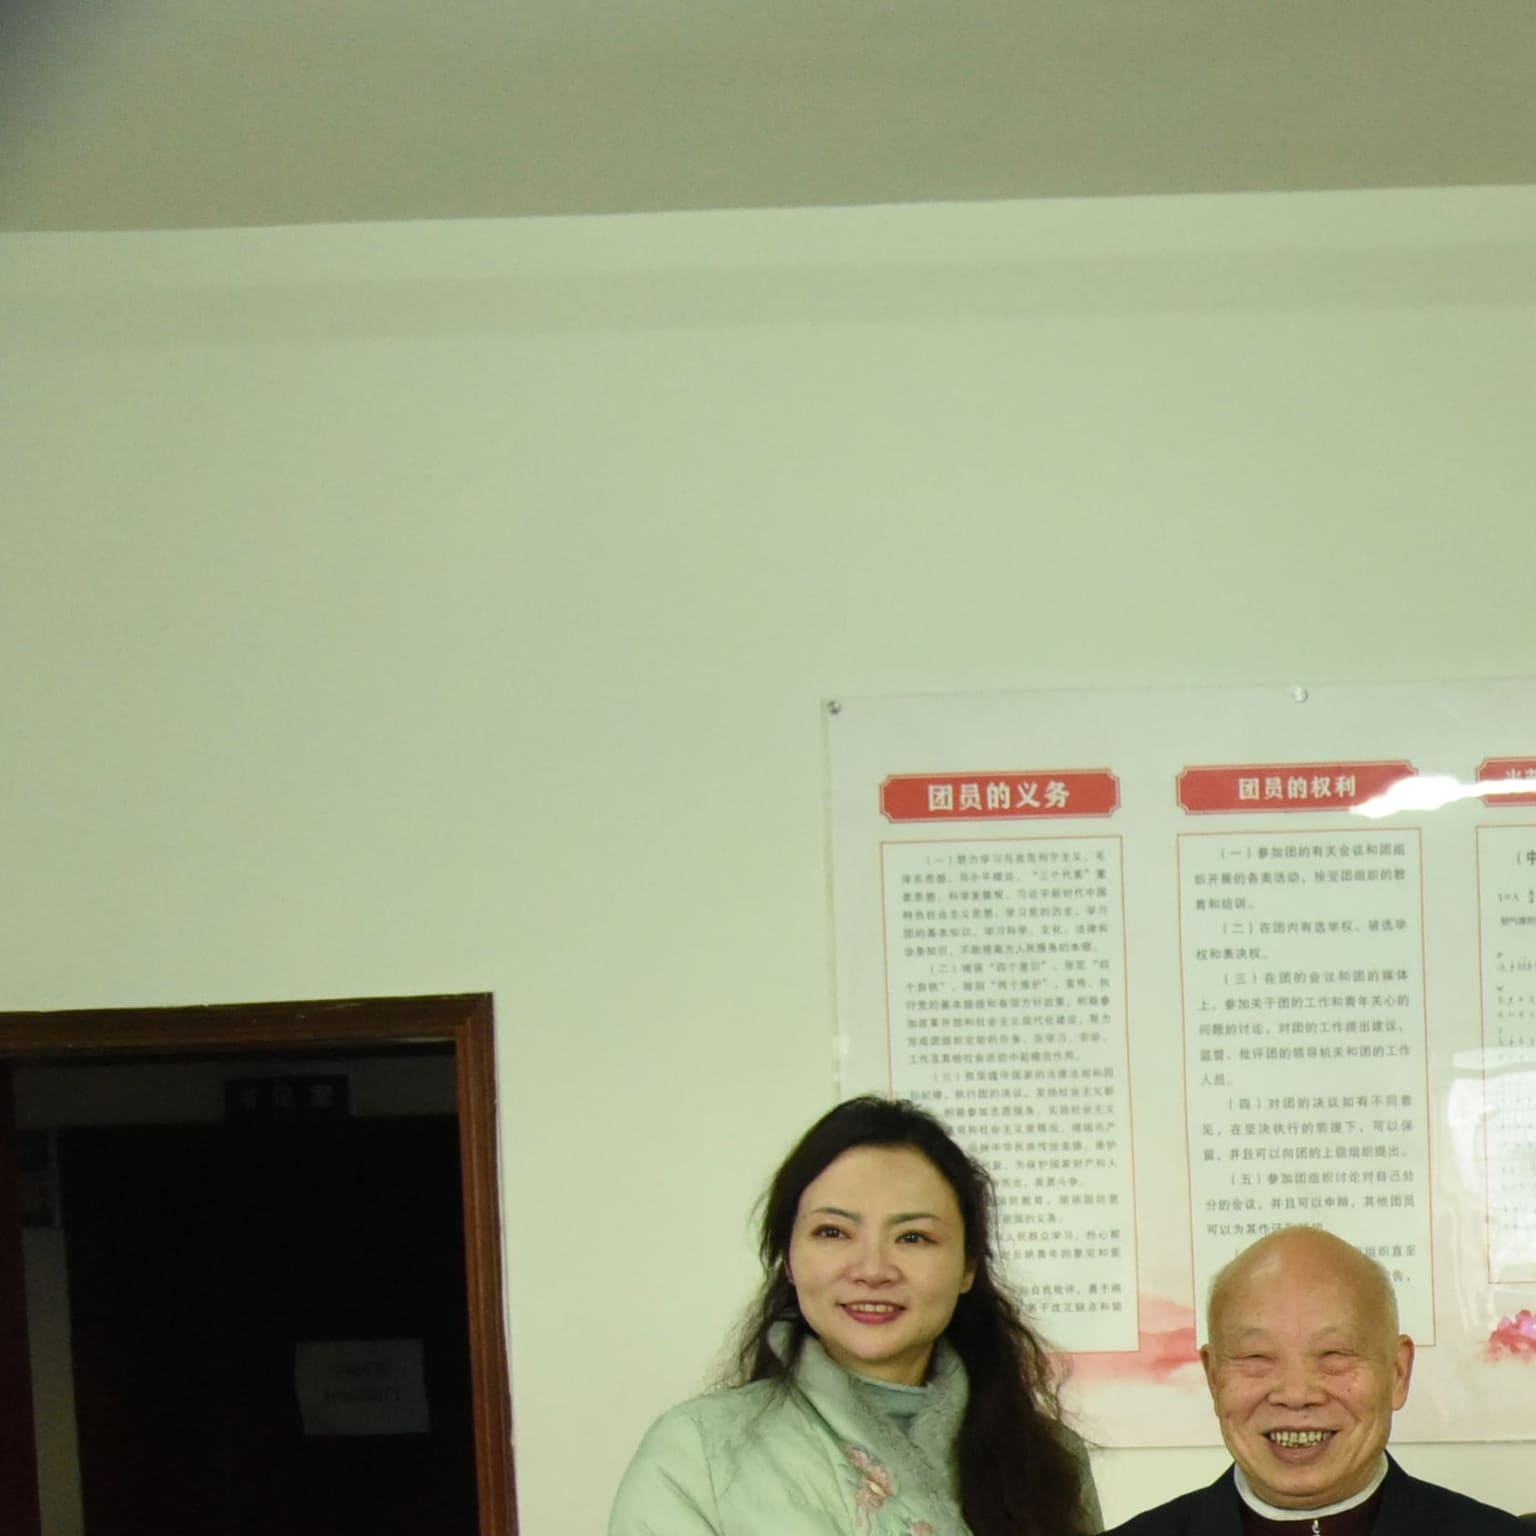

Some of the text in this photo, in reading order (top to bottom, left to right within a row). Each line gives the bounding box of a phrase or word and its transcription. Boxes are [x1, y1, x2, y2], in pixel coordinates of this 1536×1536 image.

[928, 781, 1071, 812] 团员的义务
[1237, 775, 1357, 800] 团员的权利
